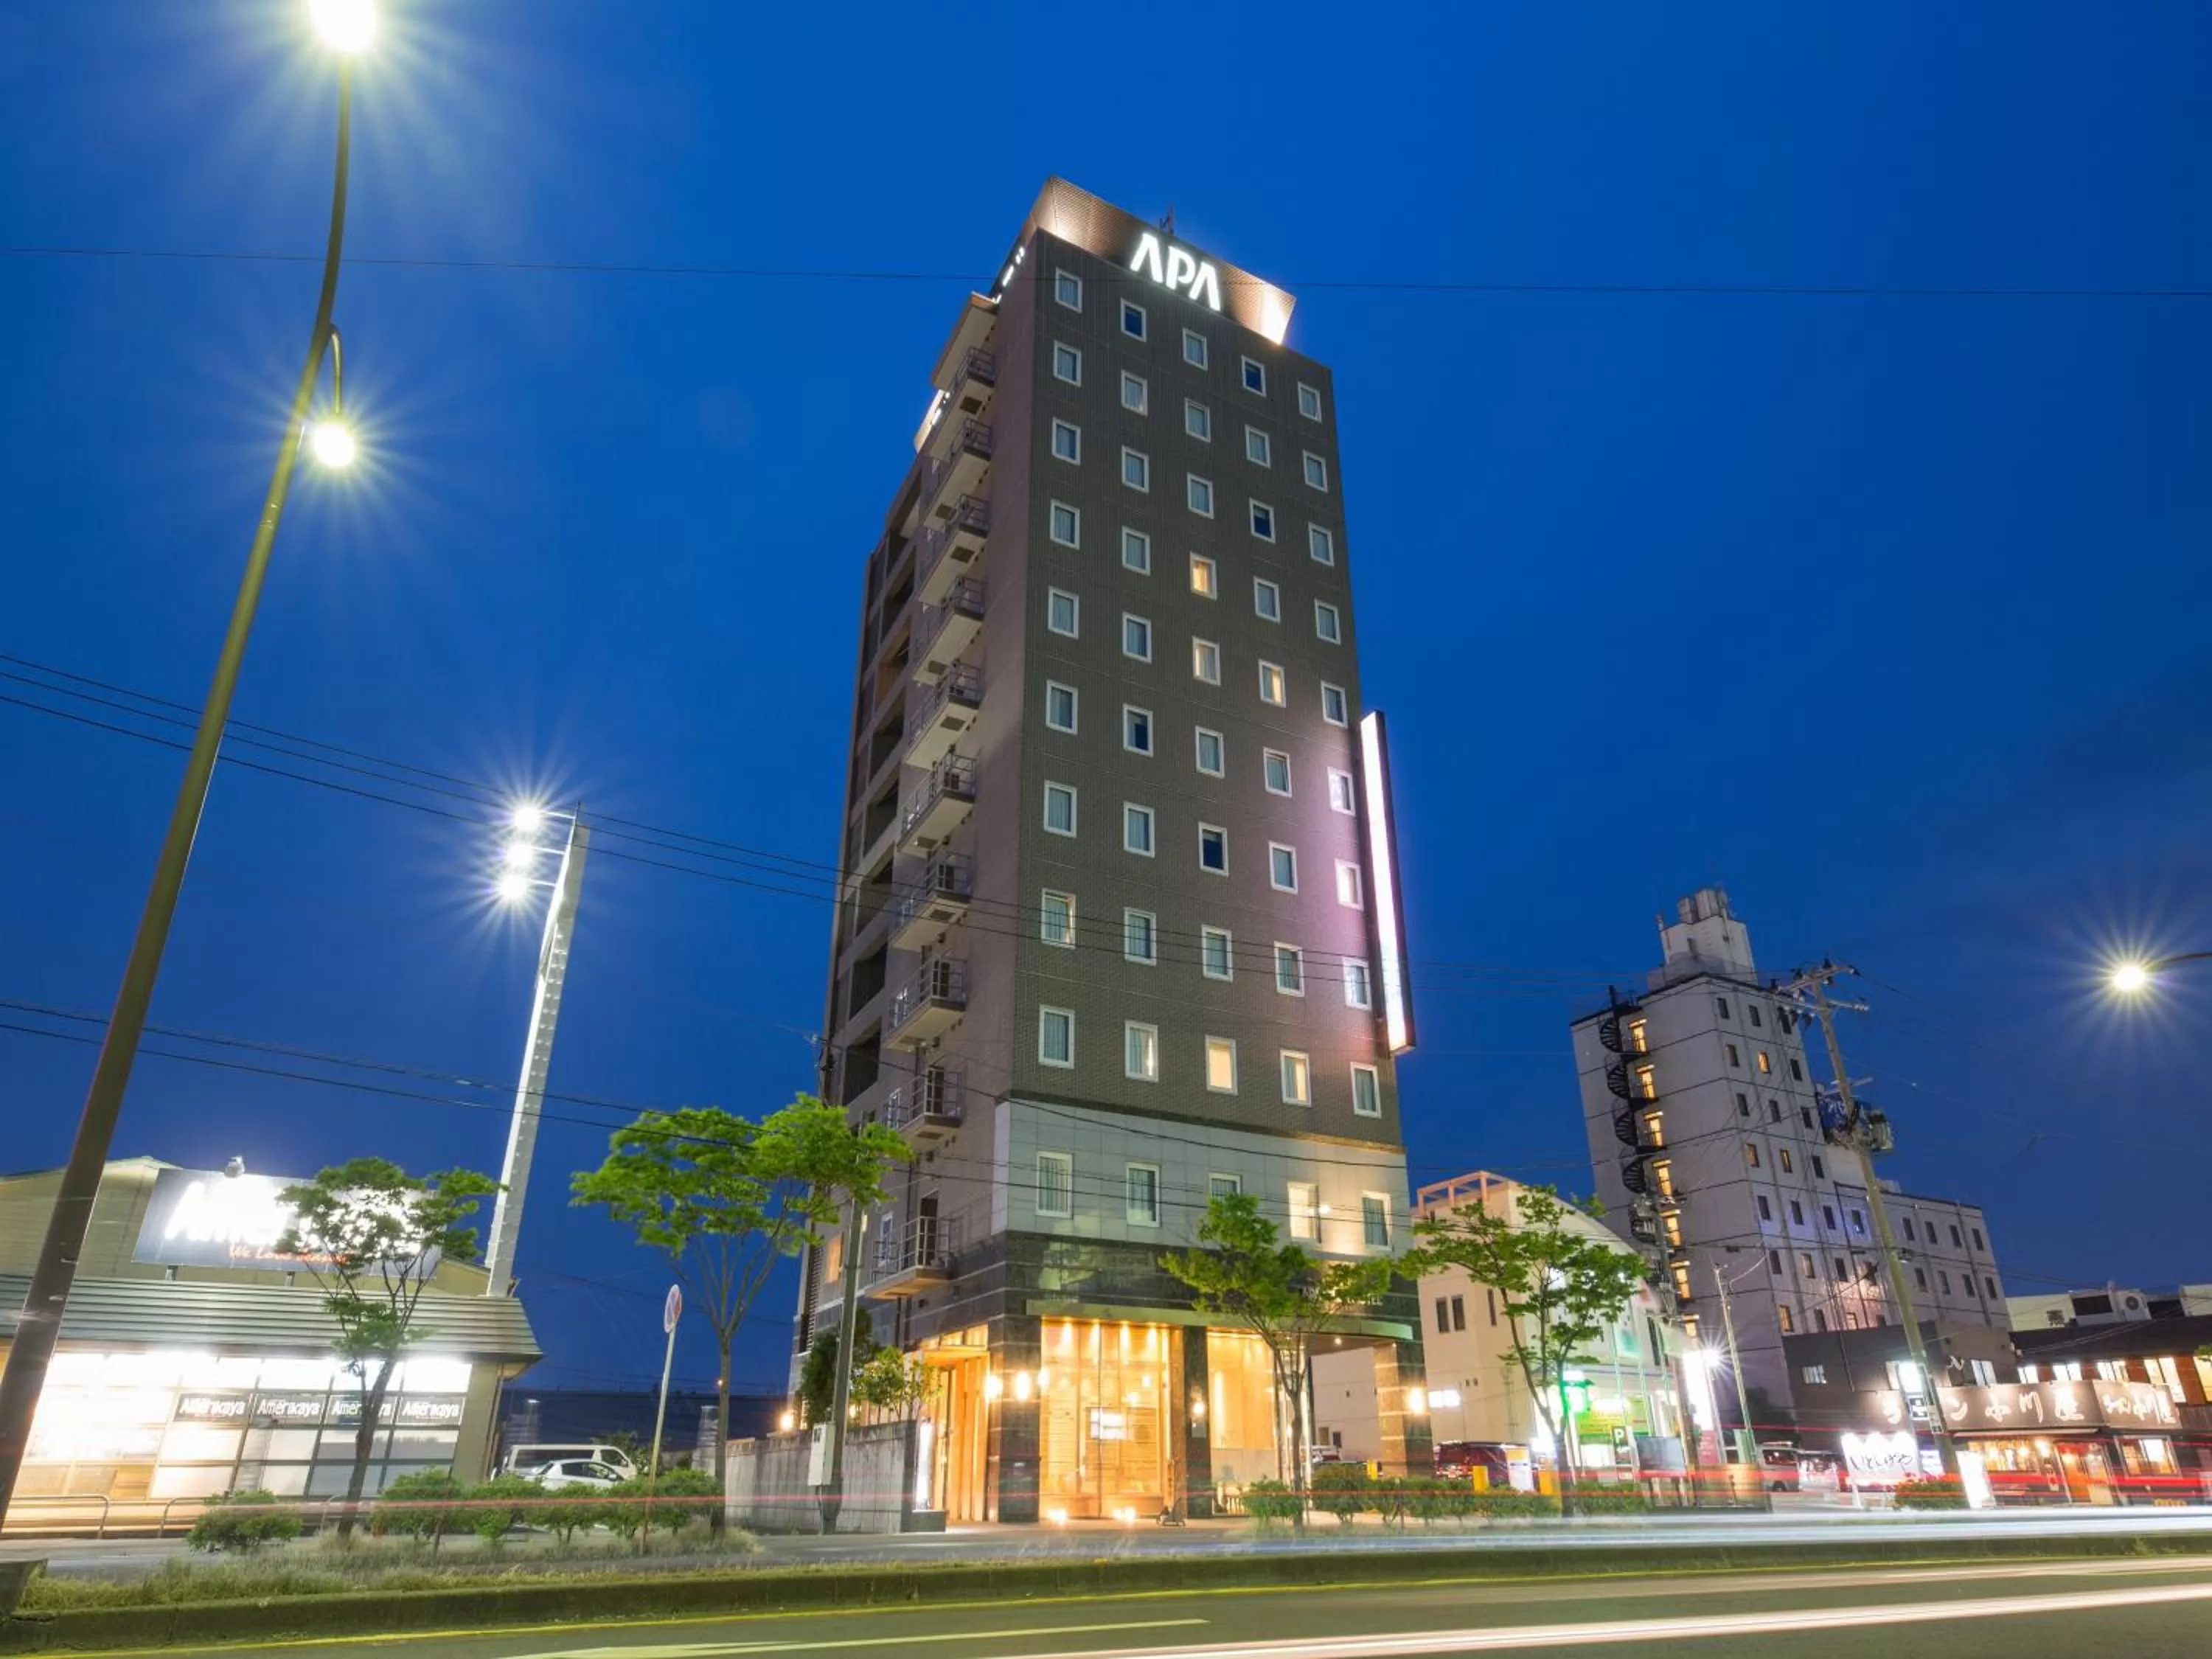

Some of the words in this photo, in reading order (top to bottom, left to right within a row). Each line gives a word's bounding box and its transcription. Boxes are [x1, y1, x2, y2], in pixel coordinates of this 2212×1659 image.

[1129, 232, 1222, 313] APA
[257, 1399, 321, 1418] Amerikaya
[1614, 1429, 1624, 1444] P
